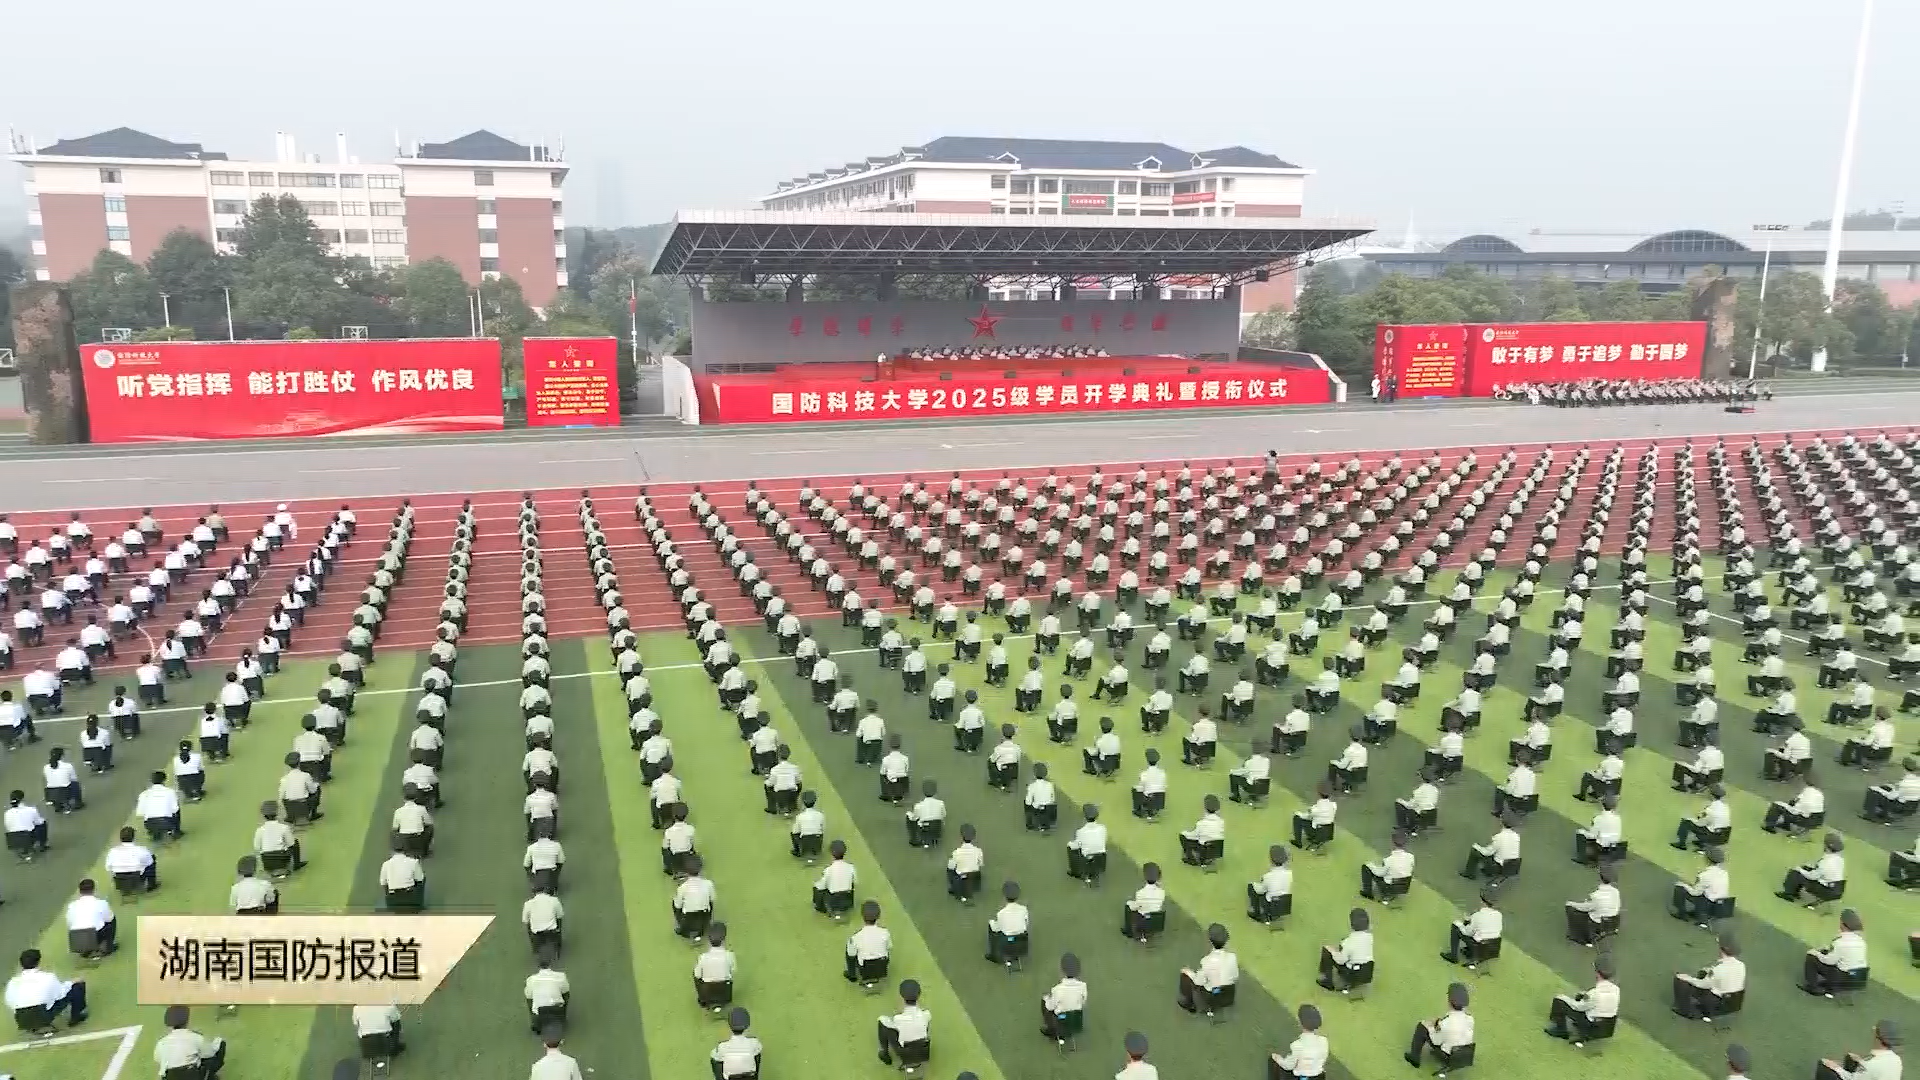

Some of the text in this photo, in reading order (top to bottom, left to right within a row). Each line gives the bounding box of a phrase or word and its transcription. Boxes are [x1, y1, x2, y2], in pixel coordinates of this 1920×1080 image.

[1491, 342, 1689, 365] 敢于有梦 勇于追梦 勤于圆梦
[116, 369, 475, 398] 听党指挥 能打胜仗 作风优良
[771, 378, 1289, 415] 国防科技大学2025级学员开学典礼暨授衔仪式
